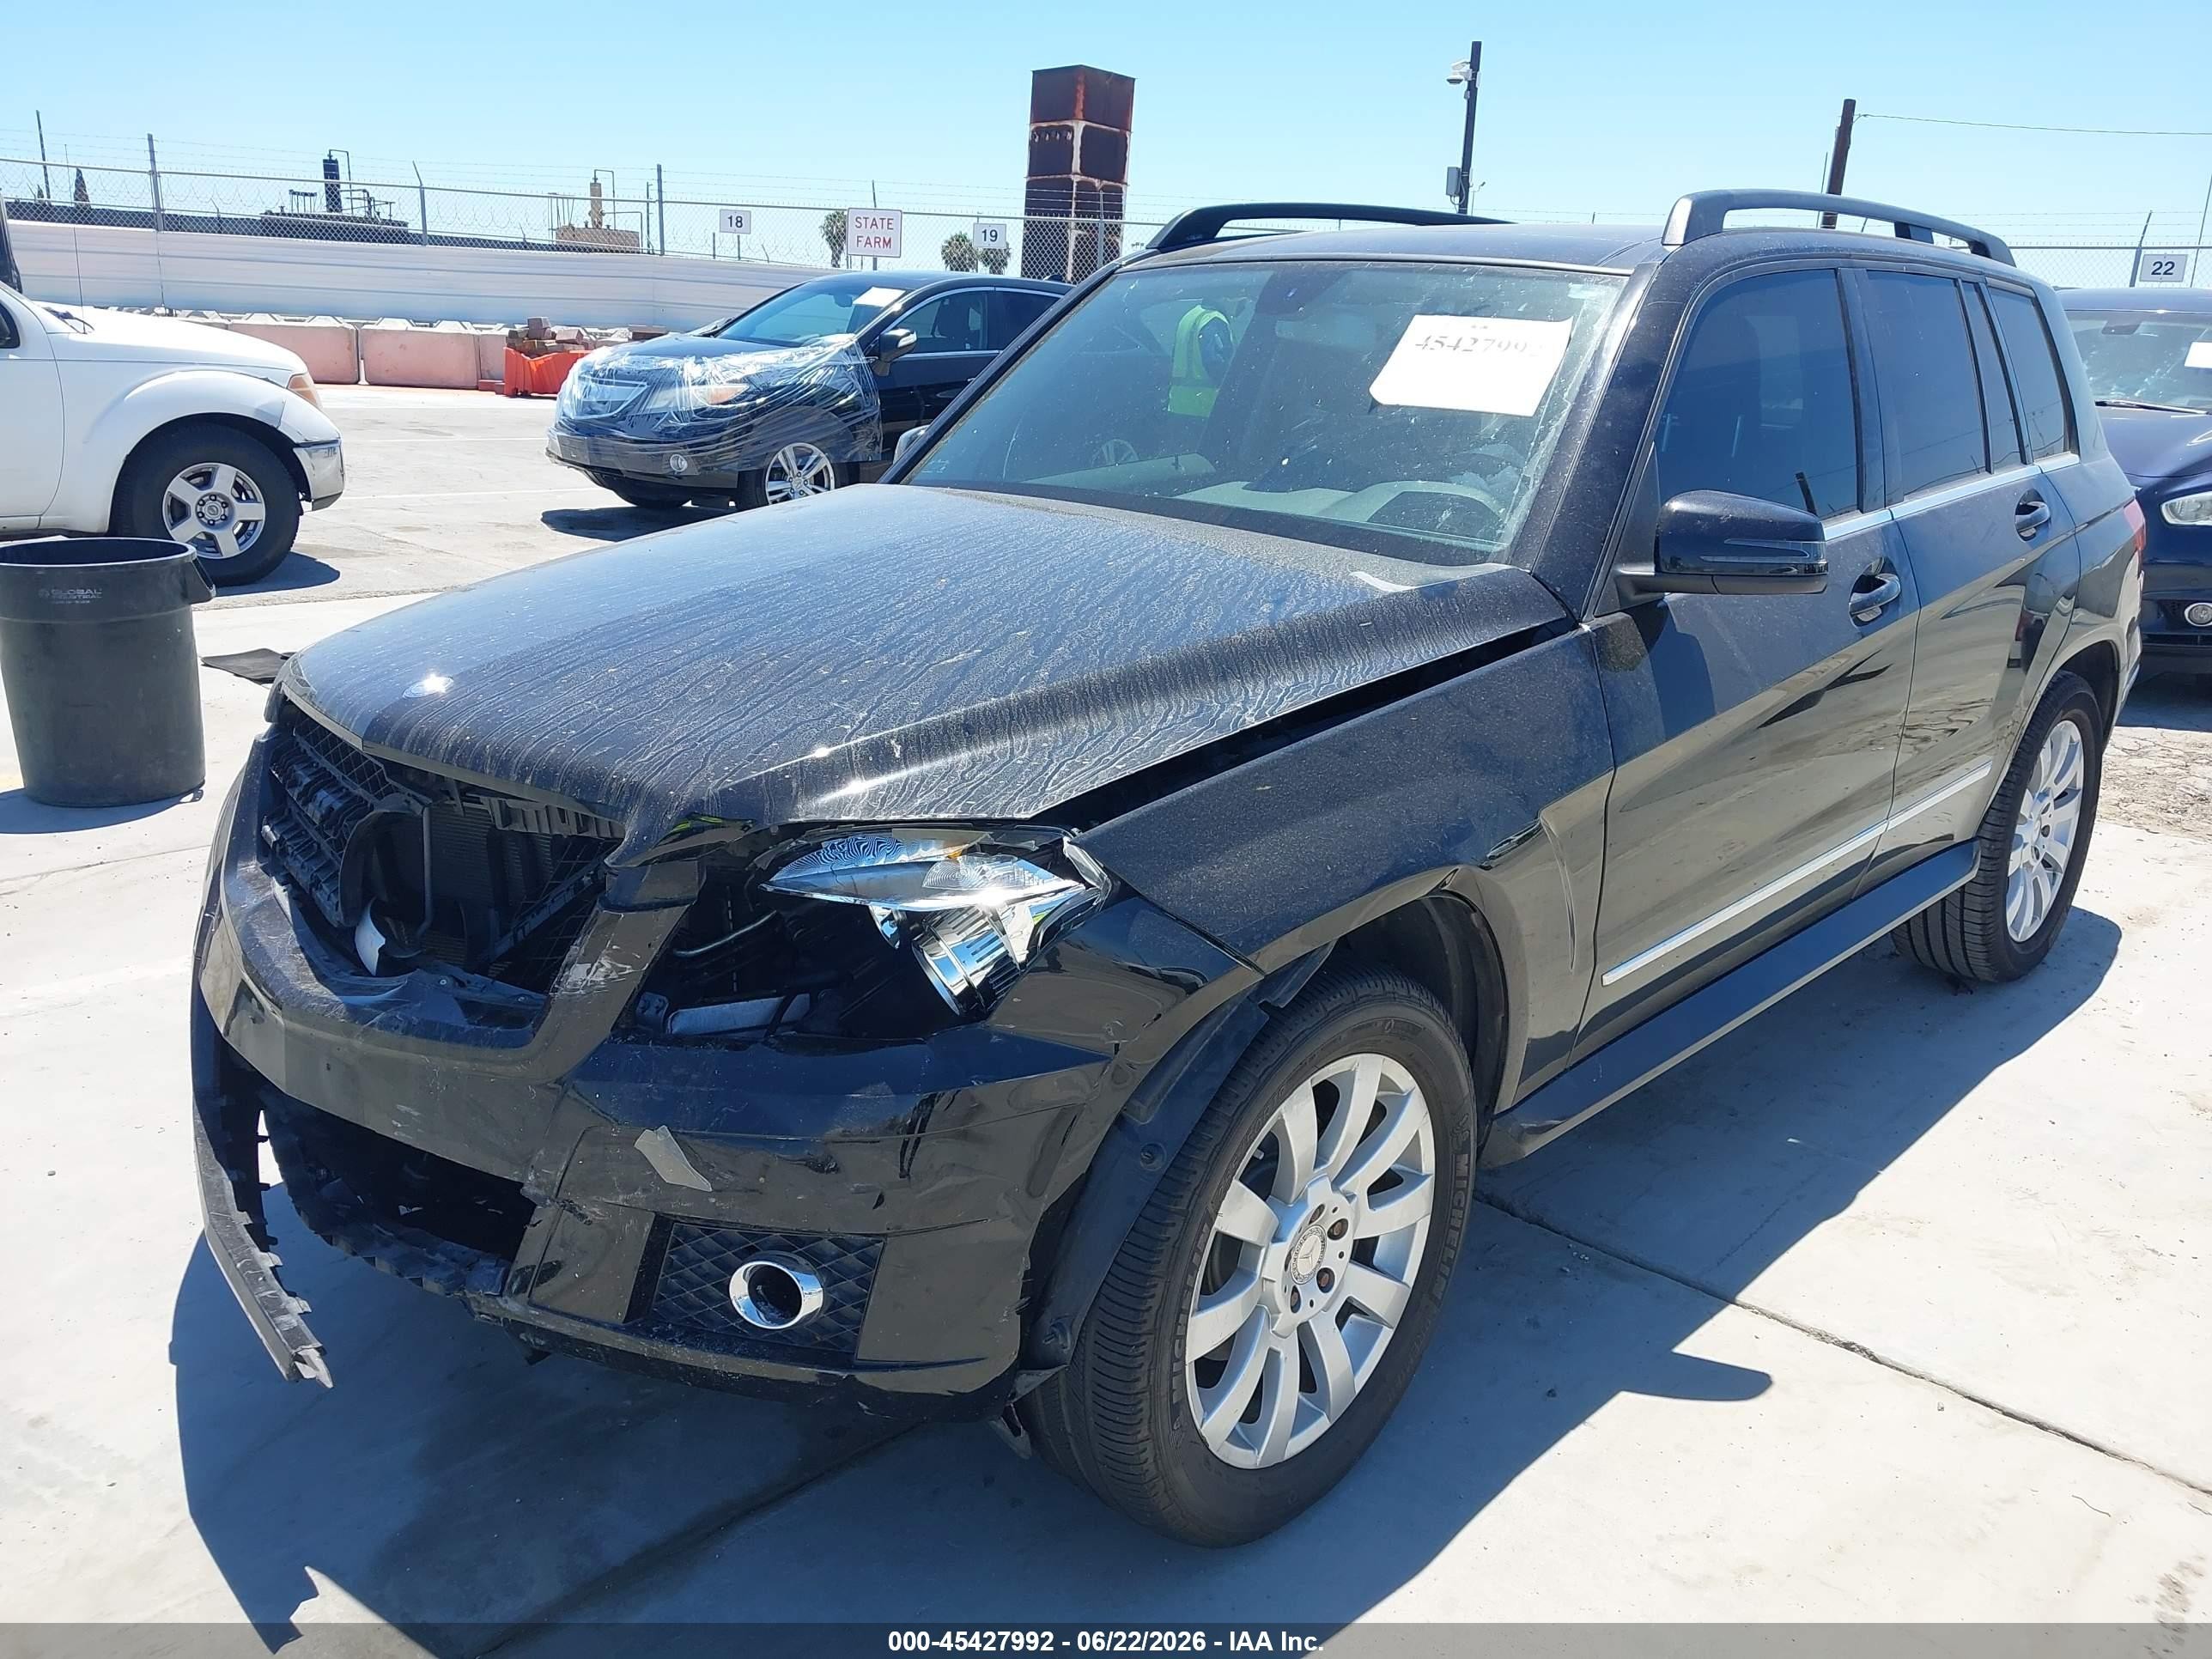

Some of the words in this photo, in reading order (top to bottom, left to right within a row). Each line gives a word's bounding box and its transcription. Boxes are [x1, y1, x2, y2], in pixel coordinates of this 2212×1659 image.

[727, 216, 744, 228] 18
[854, 216, 895, 231] STATE
[856, 235, 892, 249] FARM
[981, 229, 998, 243] 19
[2151, 261, 2175, 275] 22
[1429, 1154, 1470, 1303] MICHELIN
